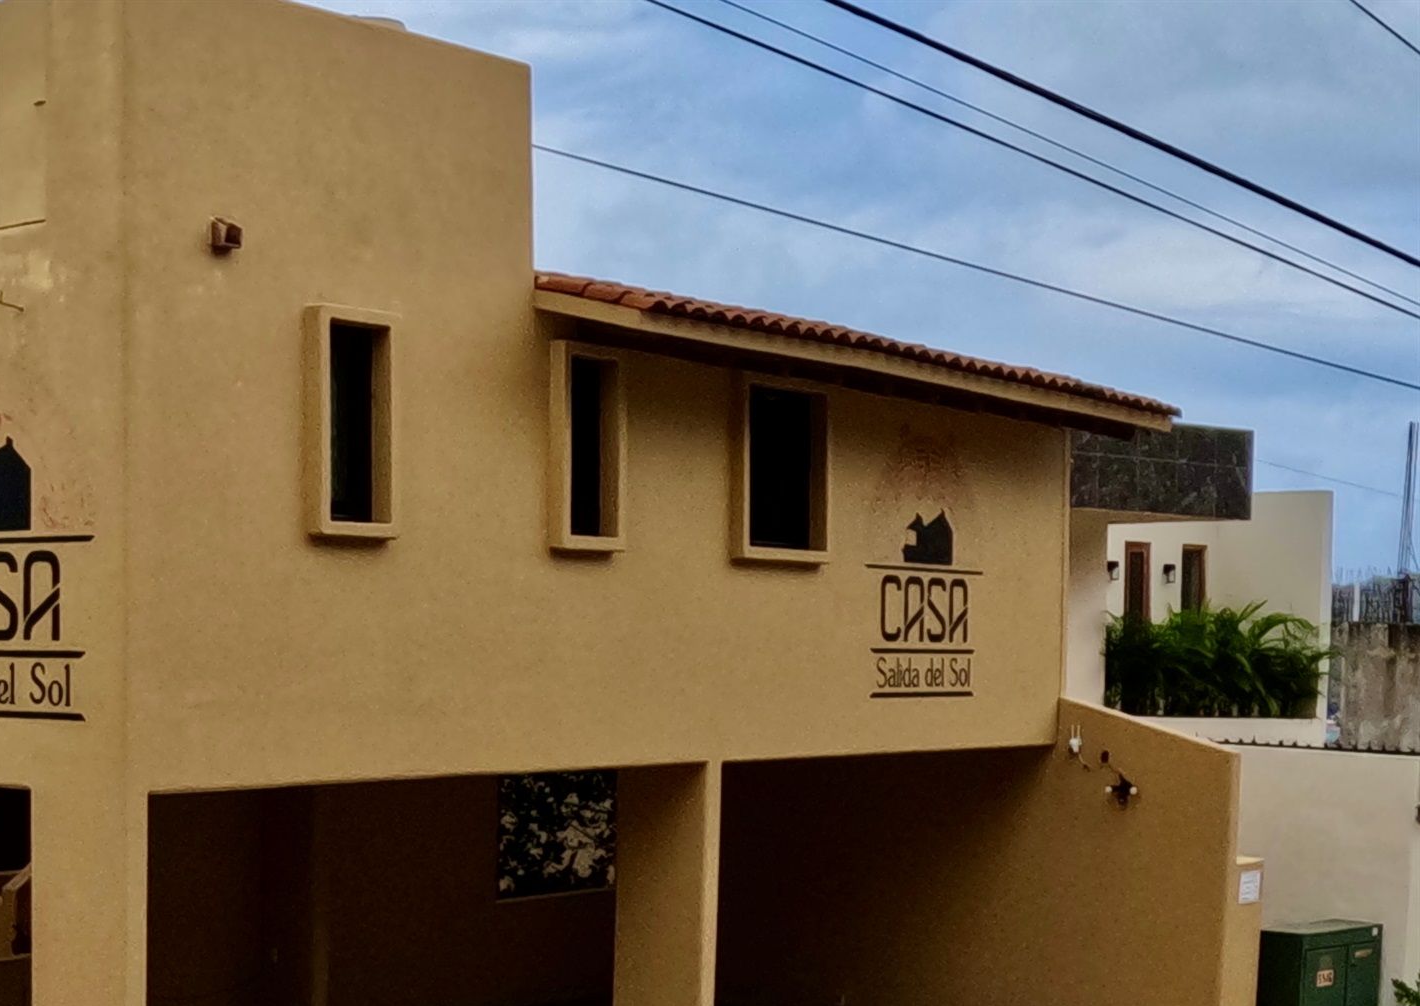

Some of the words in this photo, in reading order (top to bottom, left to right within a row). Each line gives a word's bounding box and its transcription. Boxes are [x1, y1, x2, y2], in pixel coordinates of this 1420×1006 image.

[881, 575, 968, 643] CASA
[29, 661, 71, 707] Sol
[876, 656, 920, 688] Salida
[925, 657, 944, 687] del
[949, 657, 971, 687] Sol
